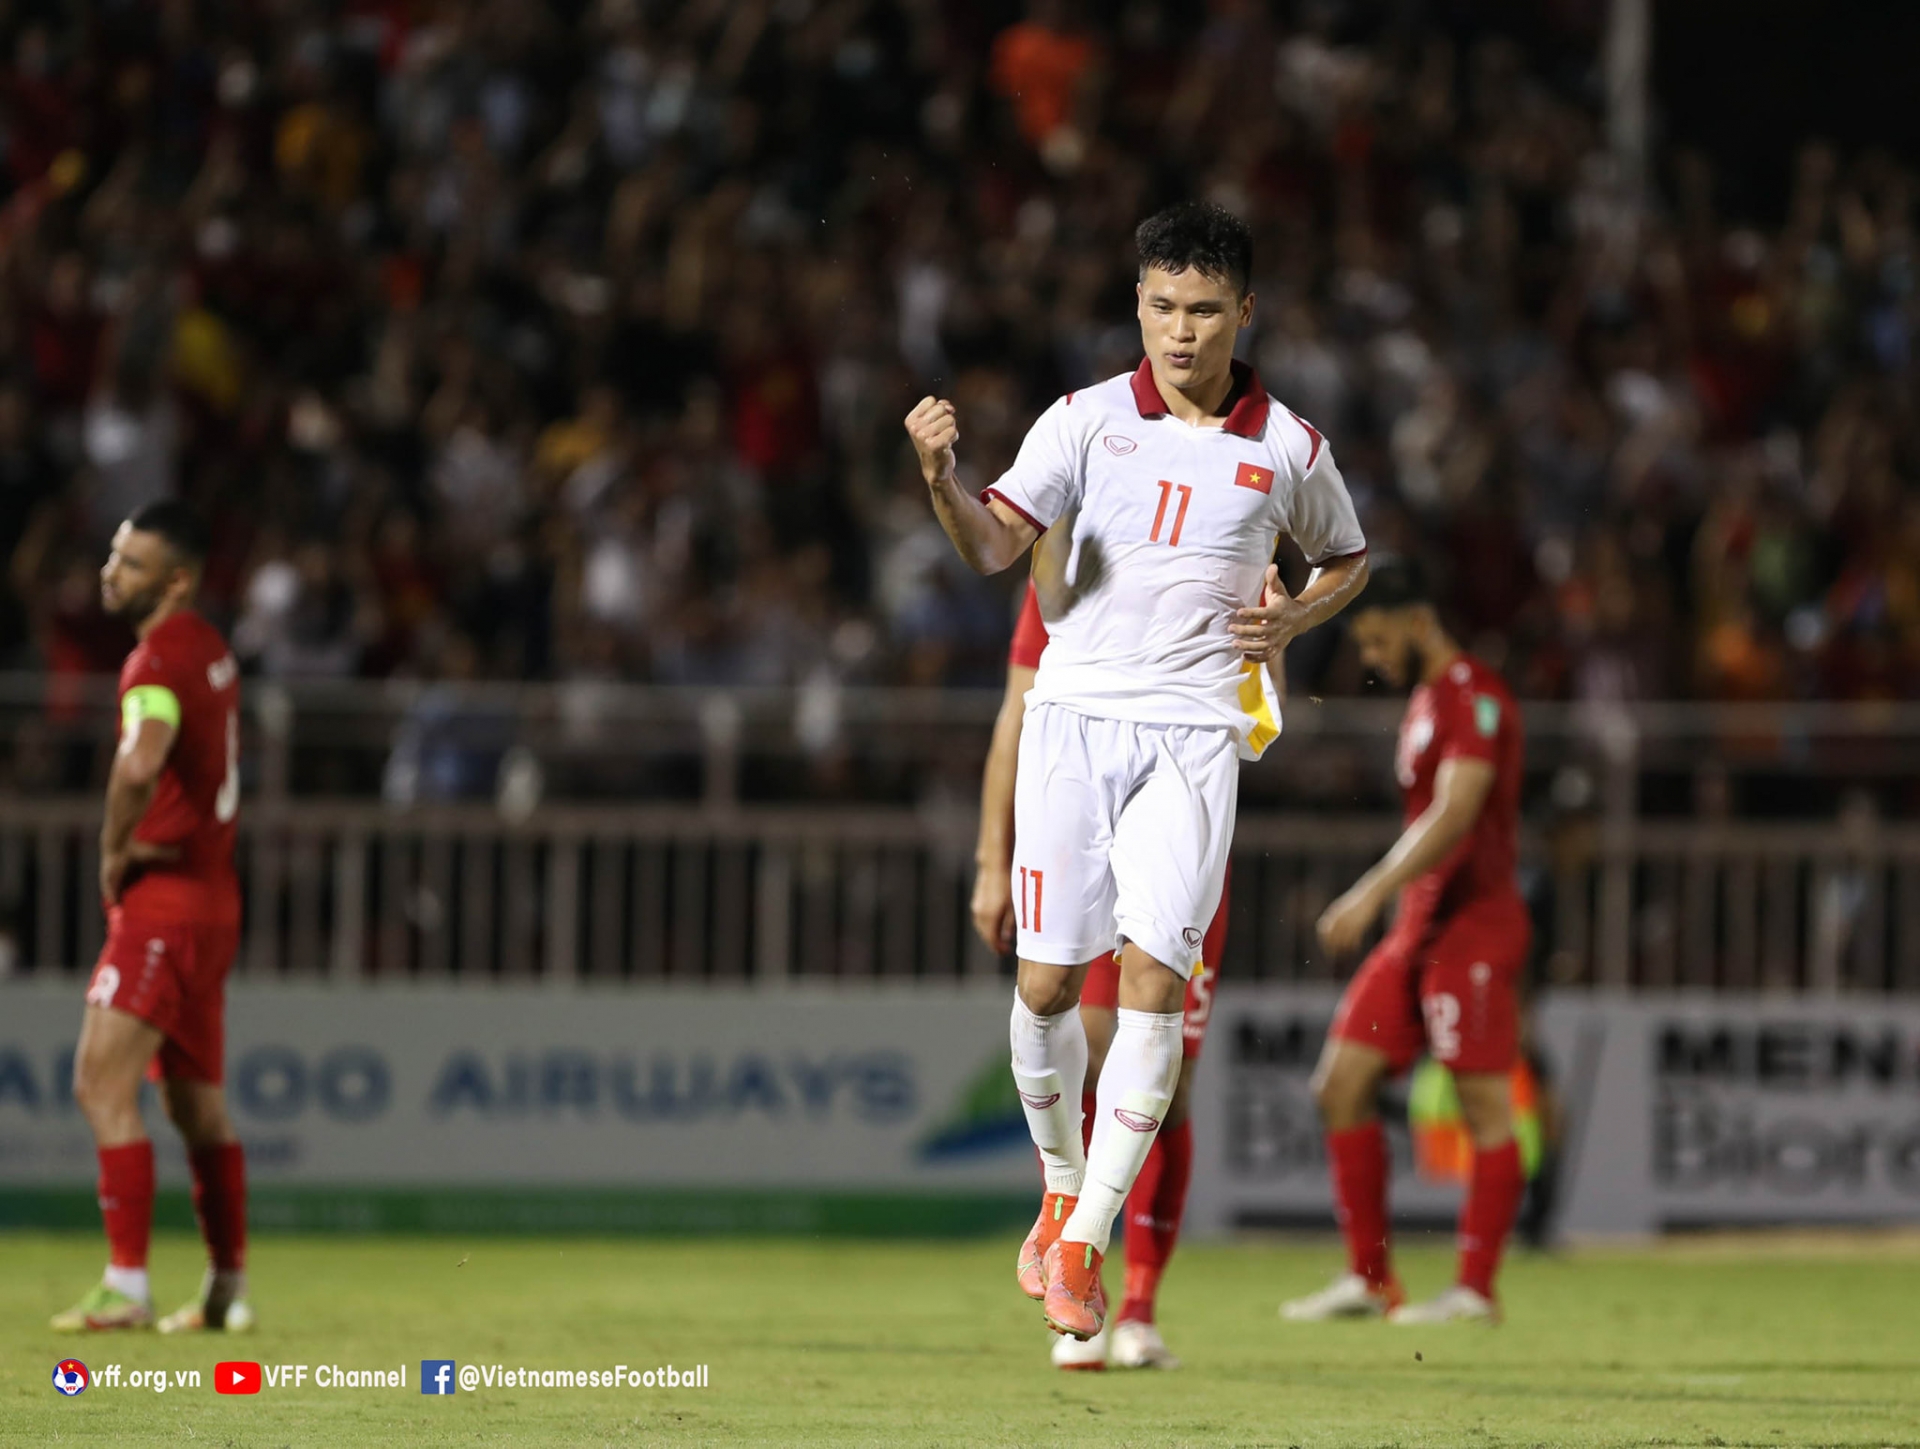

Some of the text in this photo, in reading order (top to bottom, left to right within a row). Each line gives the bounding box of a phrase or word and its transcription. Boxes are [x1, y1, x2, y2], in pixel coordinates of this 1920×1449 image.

[1148, 479, 1193, 547] 11
[1020, 866, 1043, 933] 11
[428, 1050, 916, 1125] AIRWAYS
